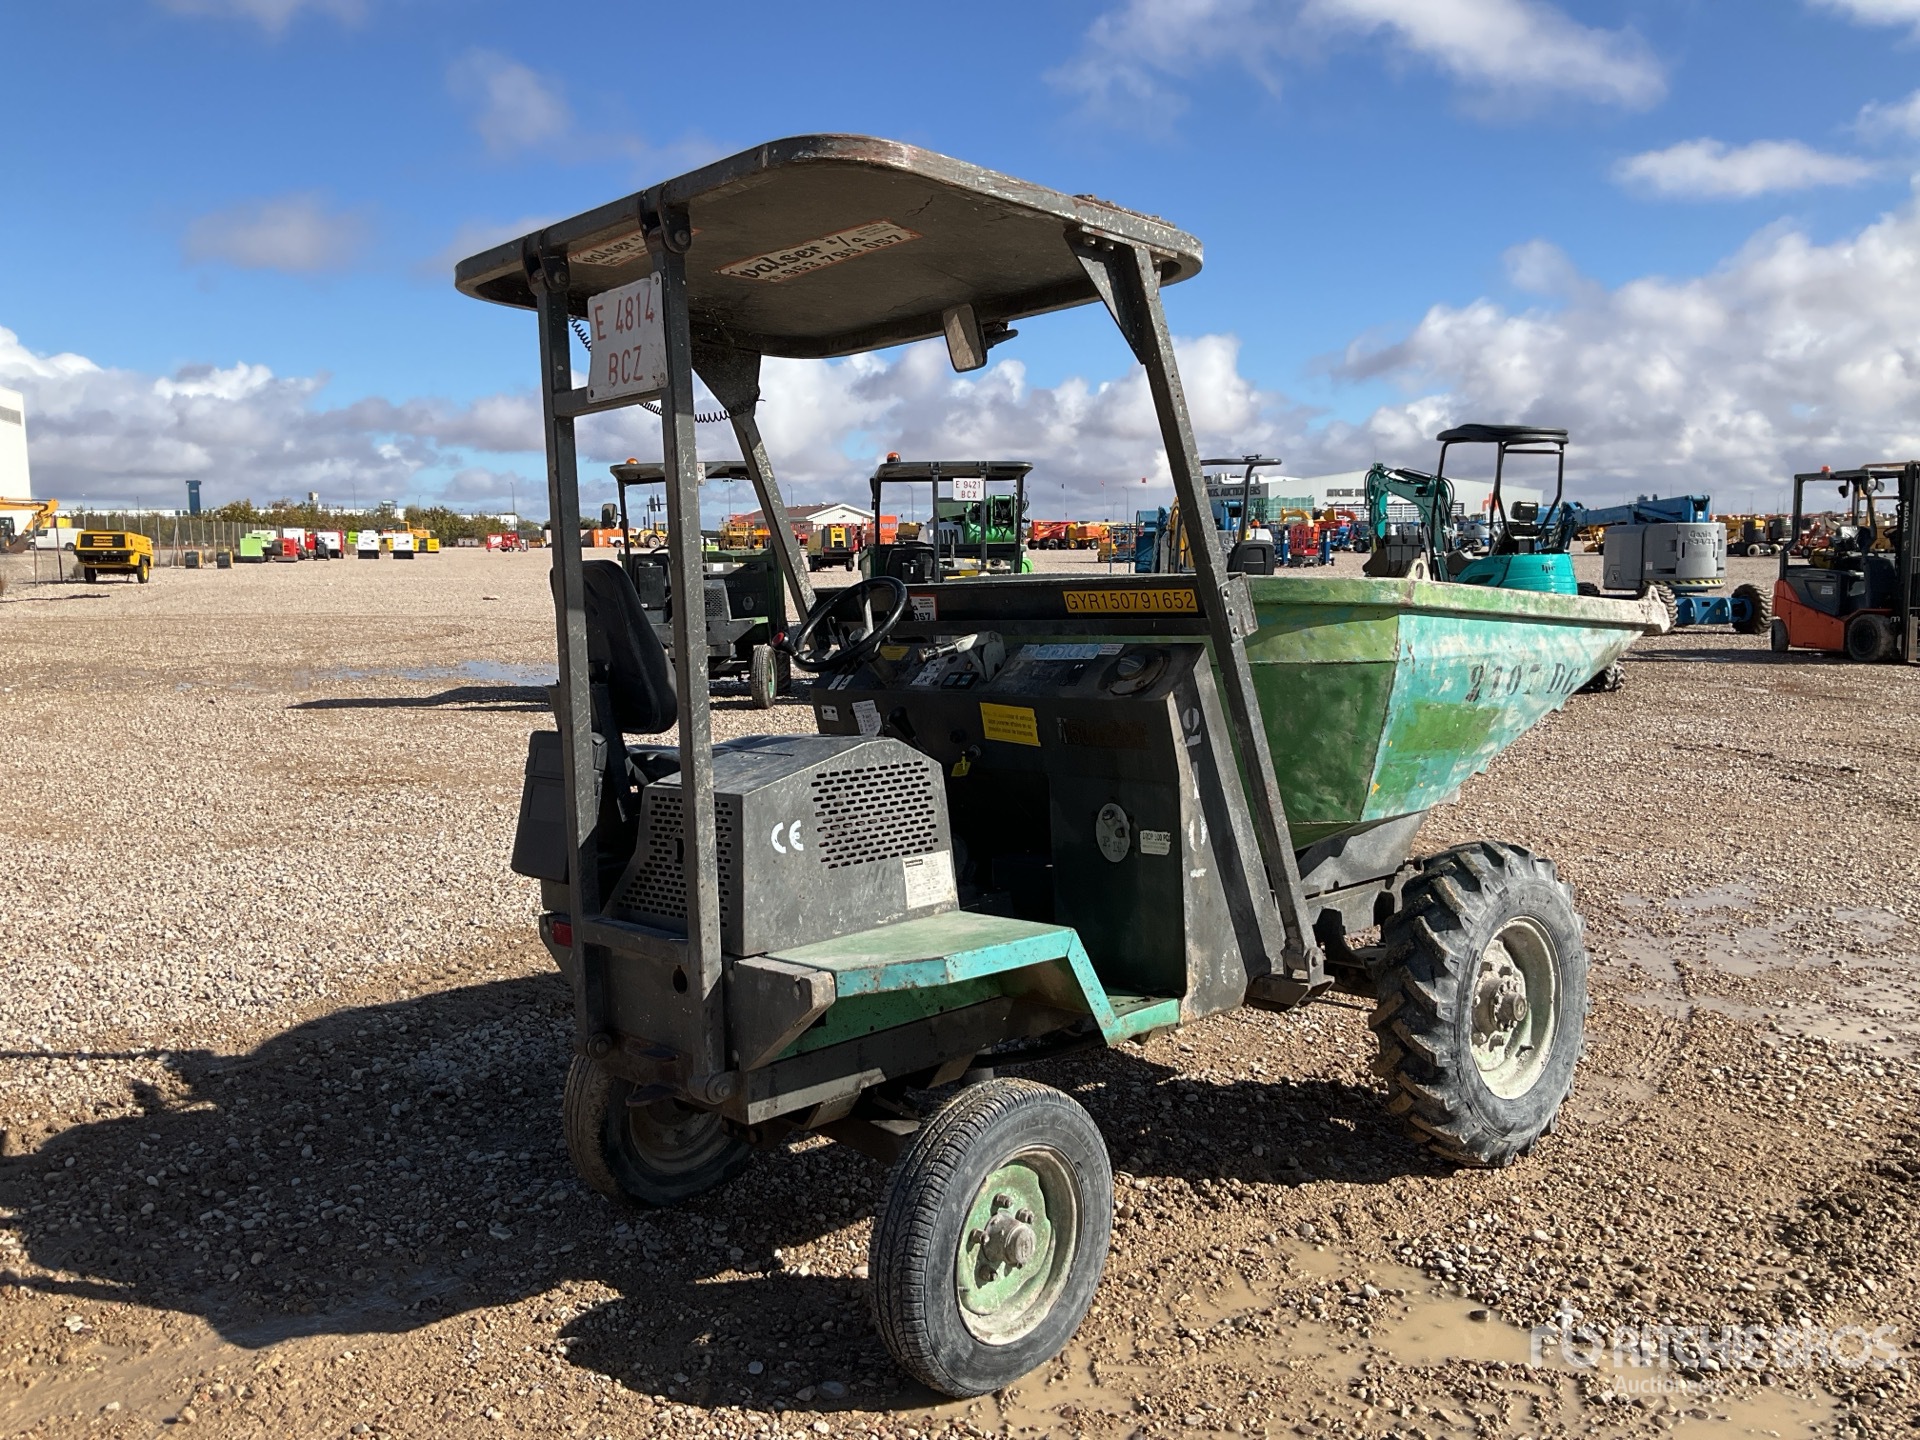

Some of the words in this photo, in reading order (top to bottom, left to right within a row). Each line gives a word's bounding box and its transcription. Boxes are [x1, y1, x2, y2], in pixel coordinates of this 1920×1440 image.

[595, 305, 607, 341] E
[616, 287, 655, 334] 4814
[608, 345, 643, 387] BCZ
[955, 480, 960, 489] E
[963, 480, 981, 489] 9421
[961, 490, 977, 499] BCX
[1902, 501, 1910, 532] TOYOTA
[1066, 591, 1196, 610] GYR150791652
